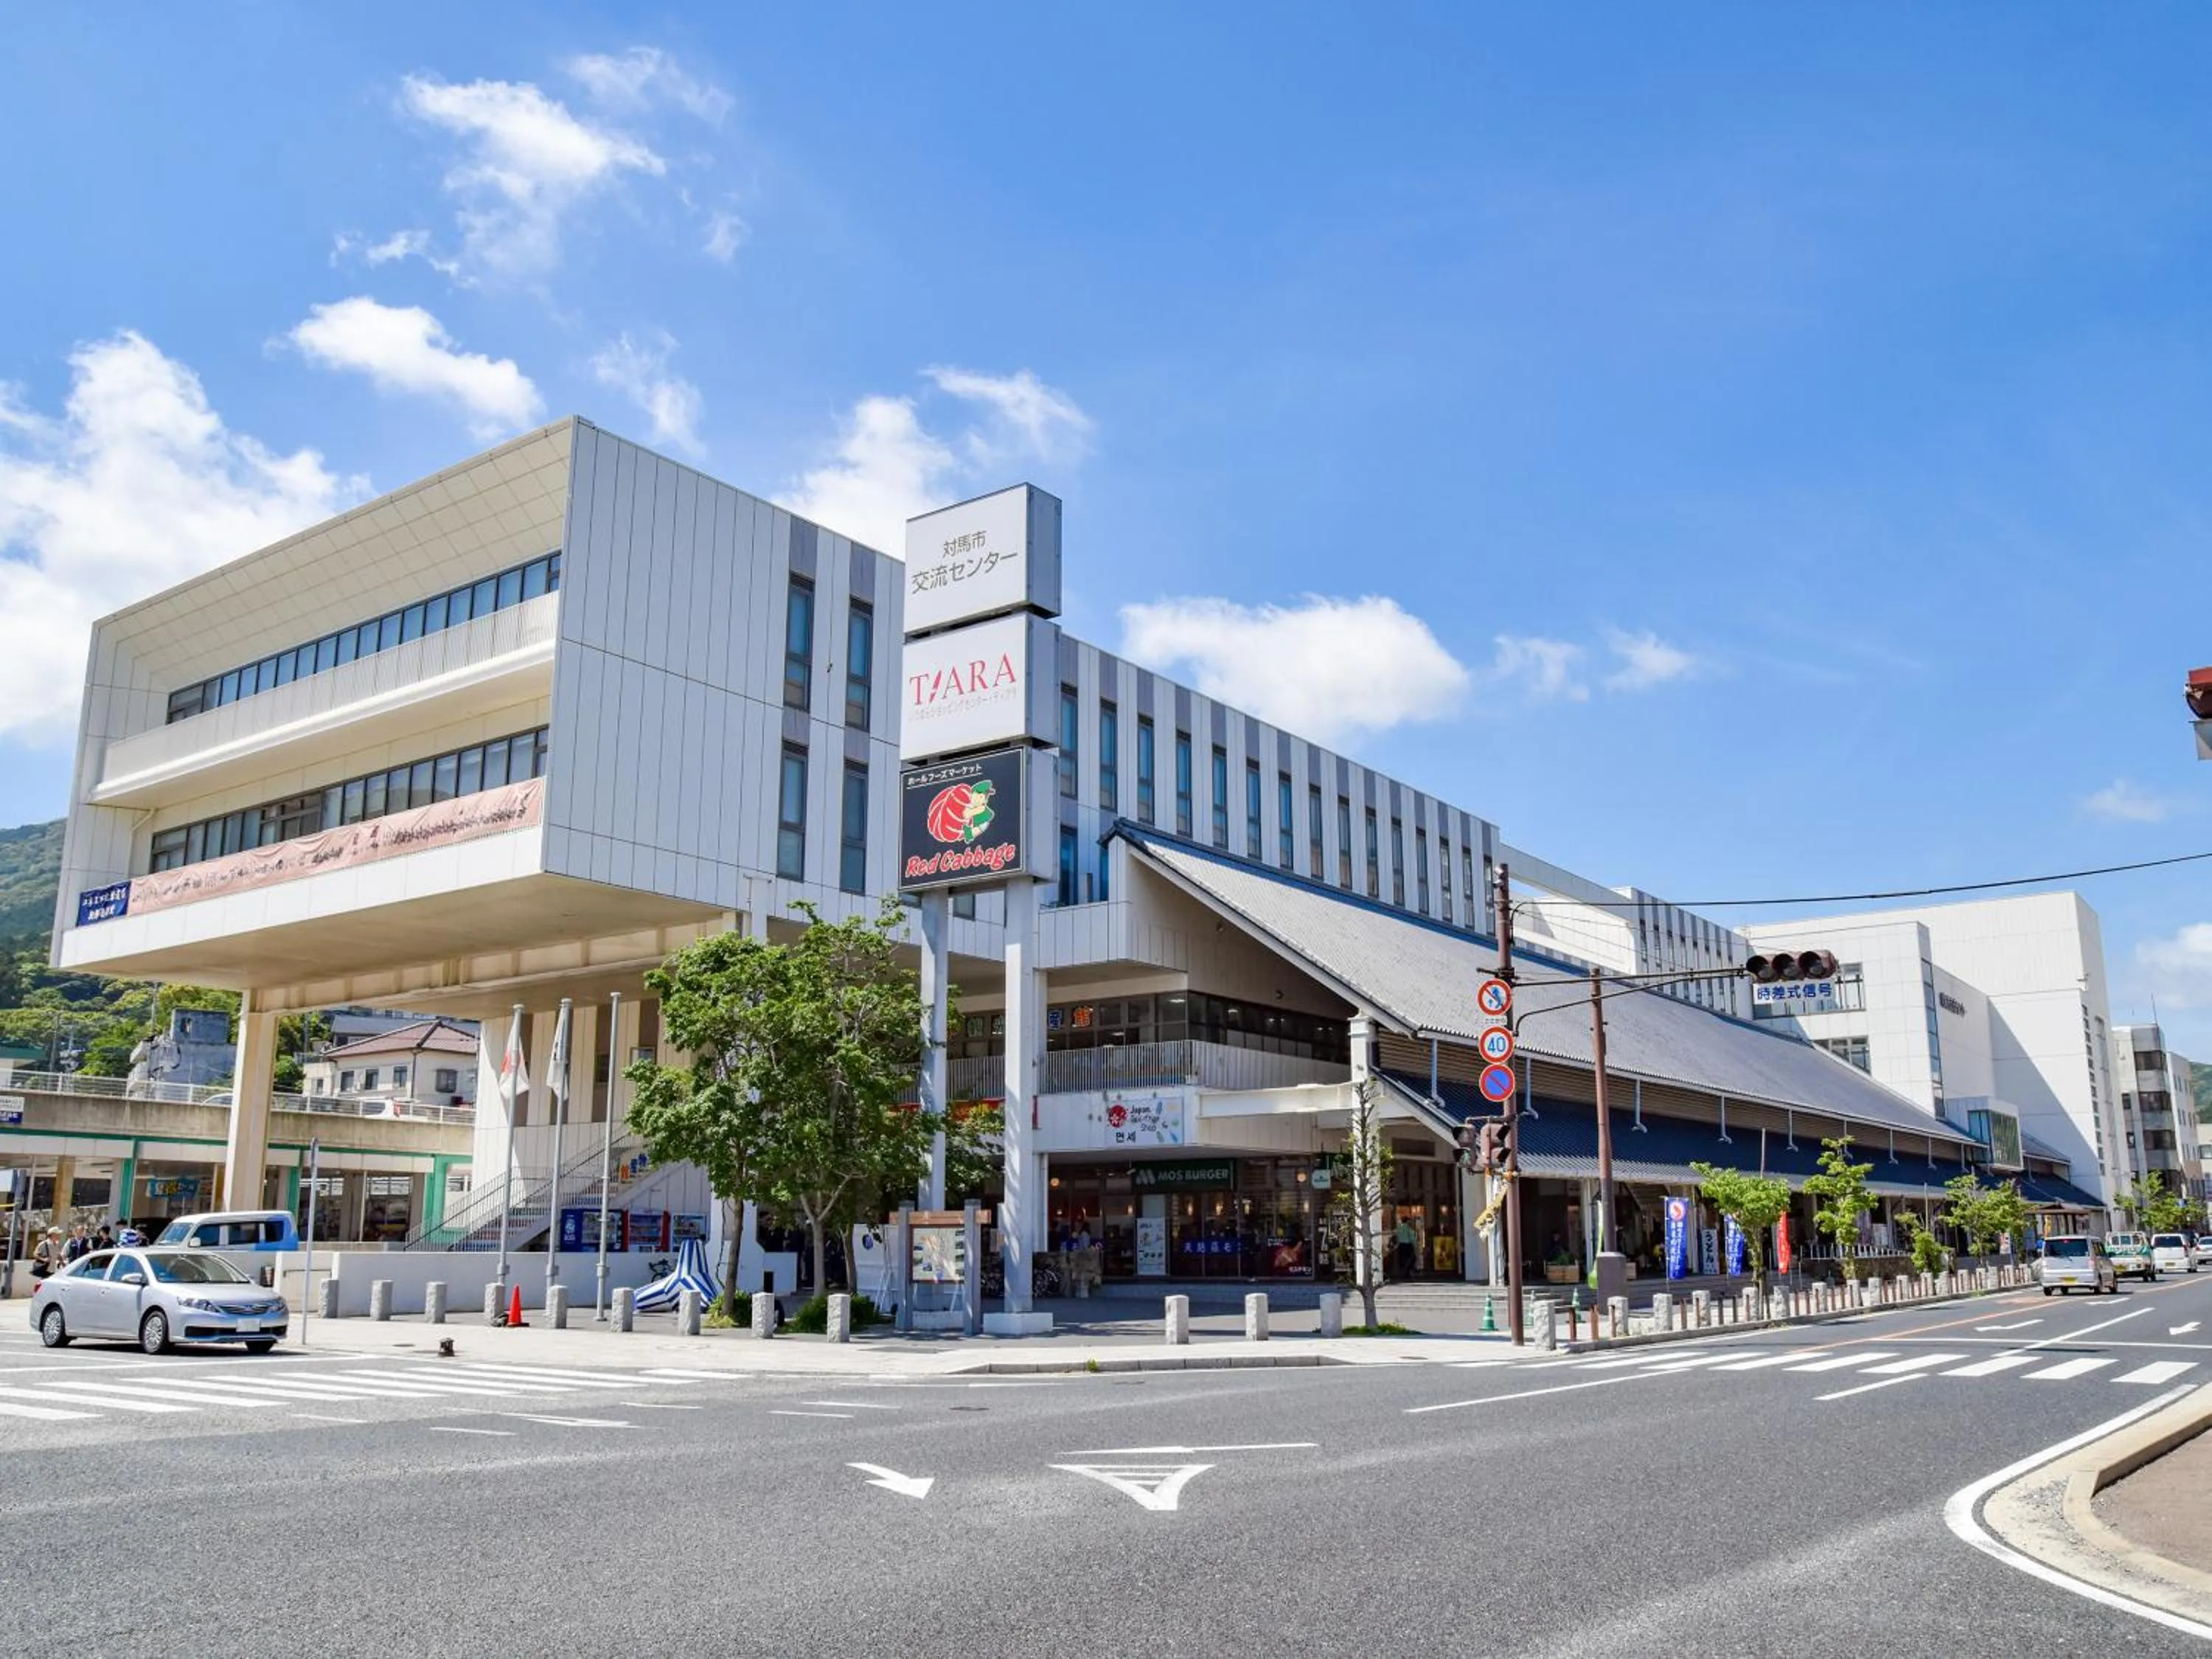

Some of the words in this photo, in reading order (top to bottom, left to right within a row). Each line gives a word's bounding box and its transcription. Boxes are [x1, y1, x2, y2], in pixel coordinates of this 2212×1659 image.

[942, 530, 987, 558] 対馬市
[911, 552, 1018, 595] 交流センター
[907, 763, 983, 786] ホールフーズマーケット
[905, 852, 941, 878] Red
[940, 842, 1017, 871] Cabbage
[1757, 982, 1832, 1001] 時差式信号
[1486, 1036, 1506, 1054] 40
[1158, 1170, 1183, 1180] MOS
[1185, 1169, 1228, 1180] BURGER
